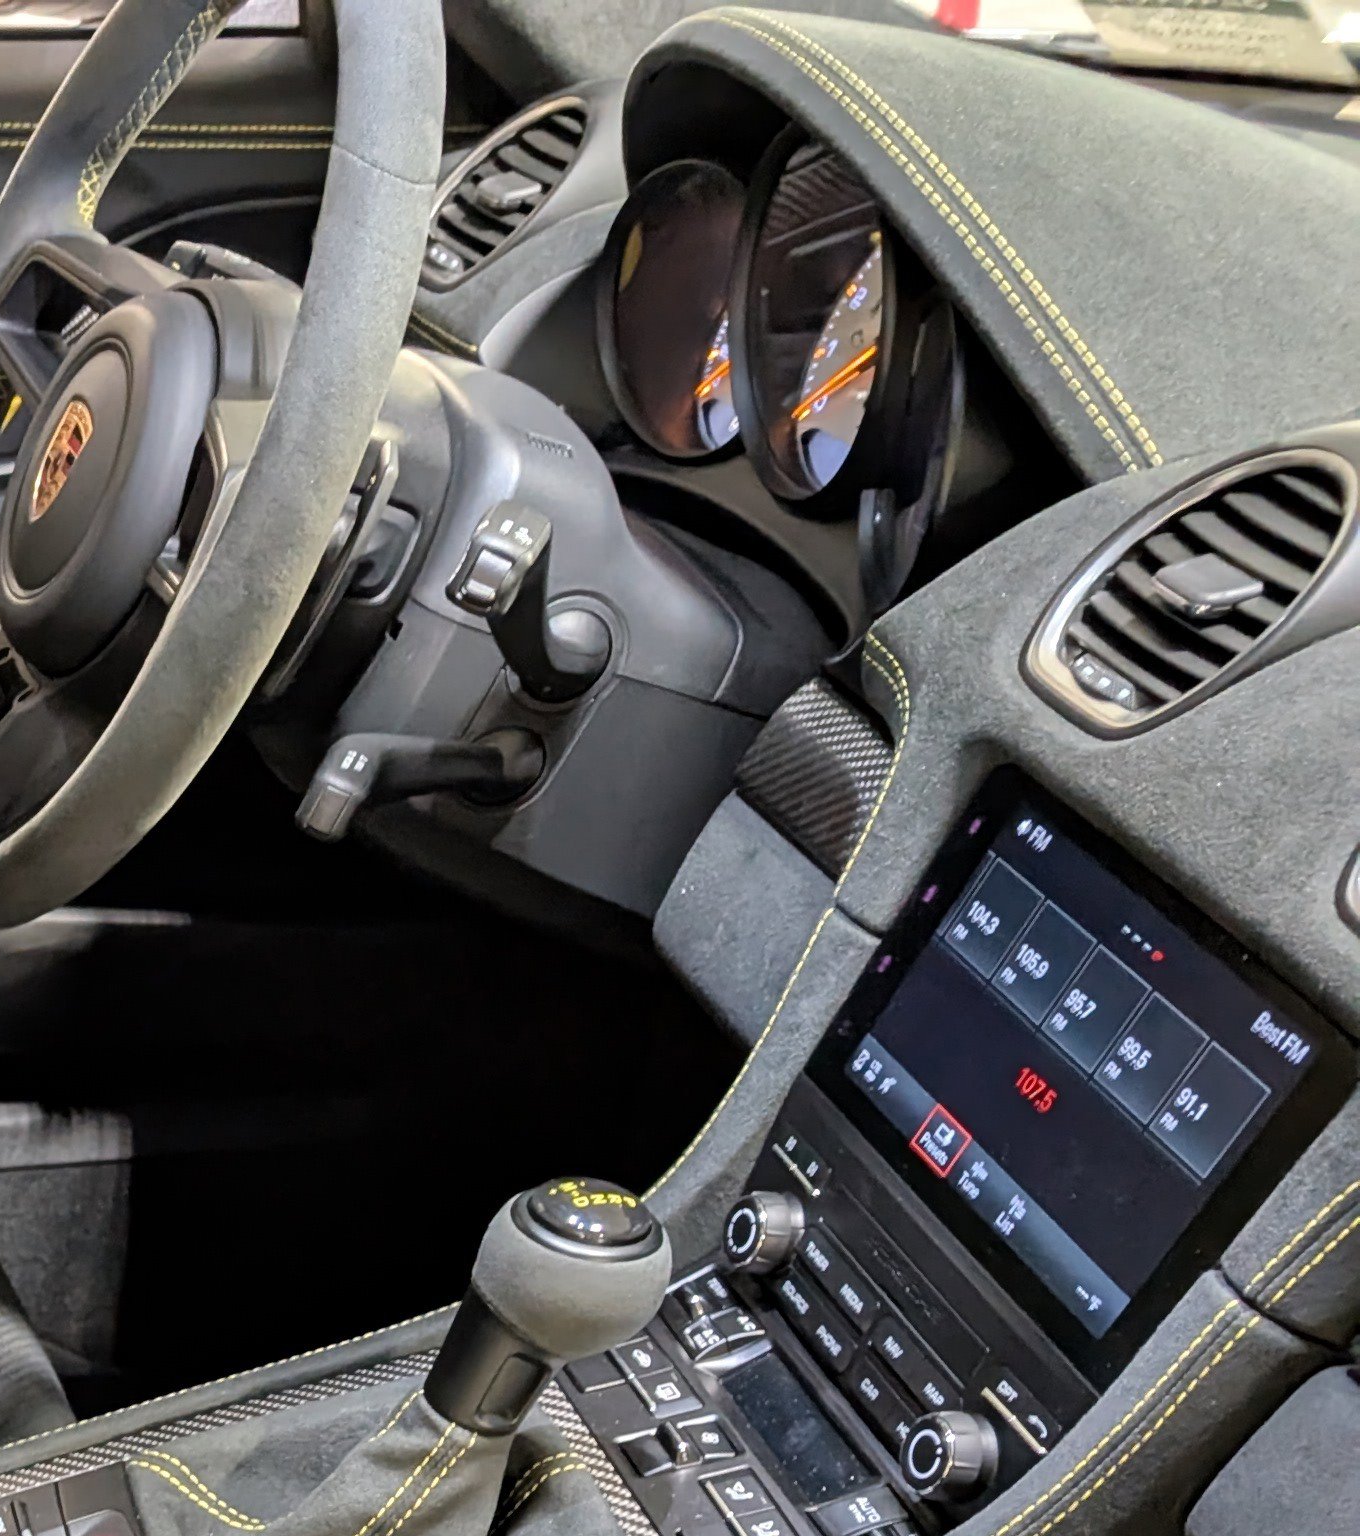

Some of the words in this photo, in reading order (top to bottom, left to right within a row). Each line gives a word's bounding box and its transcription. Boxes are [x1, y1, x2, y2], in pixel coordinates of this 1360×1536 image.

[1026, 824, 1053, 852] FM
[952, 922, 970, 941] FM
[966, 900, 1000, 936] 104.3
[1000, 966, 1018, 986] FM
[1015, 943, 1050, 980] 105.9
[1063, 988, 1097, 1021] 95.7
[1049, 1012, 1069, 1032] FM
[1249, 1010, 1287, 1053] Best
[1283, 1032, 1311, 1065] FM
[1117, 1036, 1153, 1071] 99.5
[1103, 1061, 1122, 1081] FM
[1013, 1066, 1059, 1114] 107.5
[1174, 1087, 1209, 1122] 91.1
[1159, 1112, 1179, 1132] FM
[918, 1130, 949, 1167] Presets
[957, 1170, 981, 1200] Tune
[994, 1210, 1016, 1236] List
[805, 1240, 830, 1272] TUNER
[781, 1279, 810, 1315] SOURCE
[839, 1282, 864, 1315] MEDIA
[815, 1324, 843, 1358] PHONE
[883, 1335, 904, 1360] NAV
[859, 1377, 880, 1401] CAR
[922, 1381, 945, 1407] MAP
[995, 1378, 1019, 1403] OPT
[854, 1496, 881, 1524] AUTO
